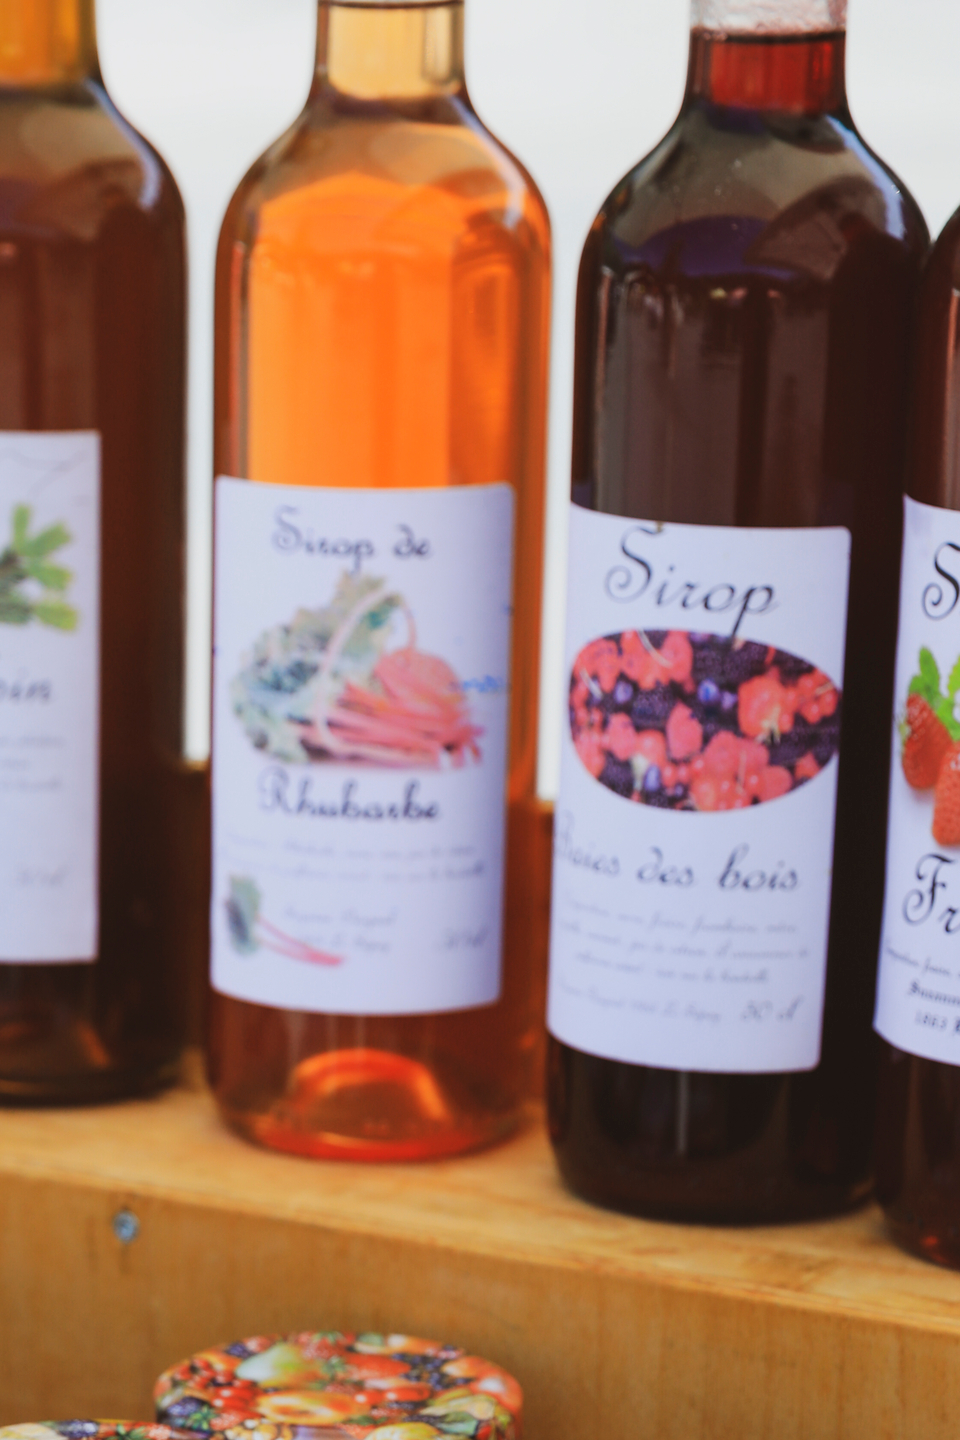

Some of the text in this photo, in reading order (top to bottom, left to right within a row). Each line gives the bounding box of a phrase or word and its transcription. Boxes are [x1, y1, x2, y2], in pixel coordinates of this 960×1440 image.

[271, 503, 430, 575] Sirop de
[604, 525, 780, 636] Sirop
[258, 765, 439, 820] Rhubarbe
[637, 845, 695, 886] des
[718, 842, 799, 890] bois
